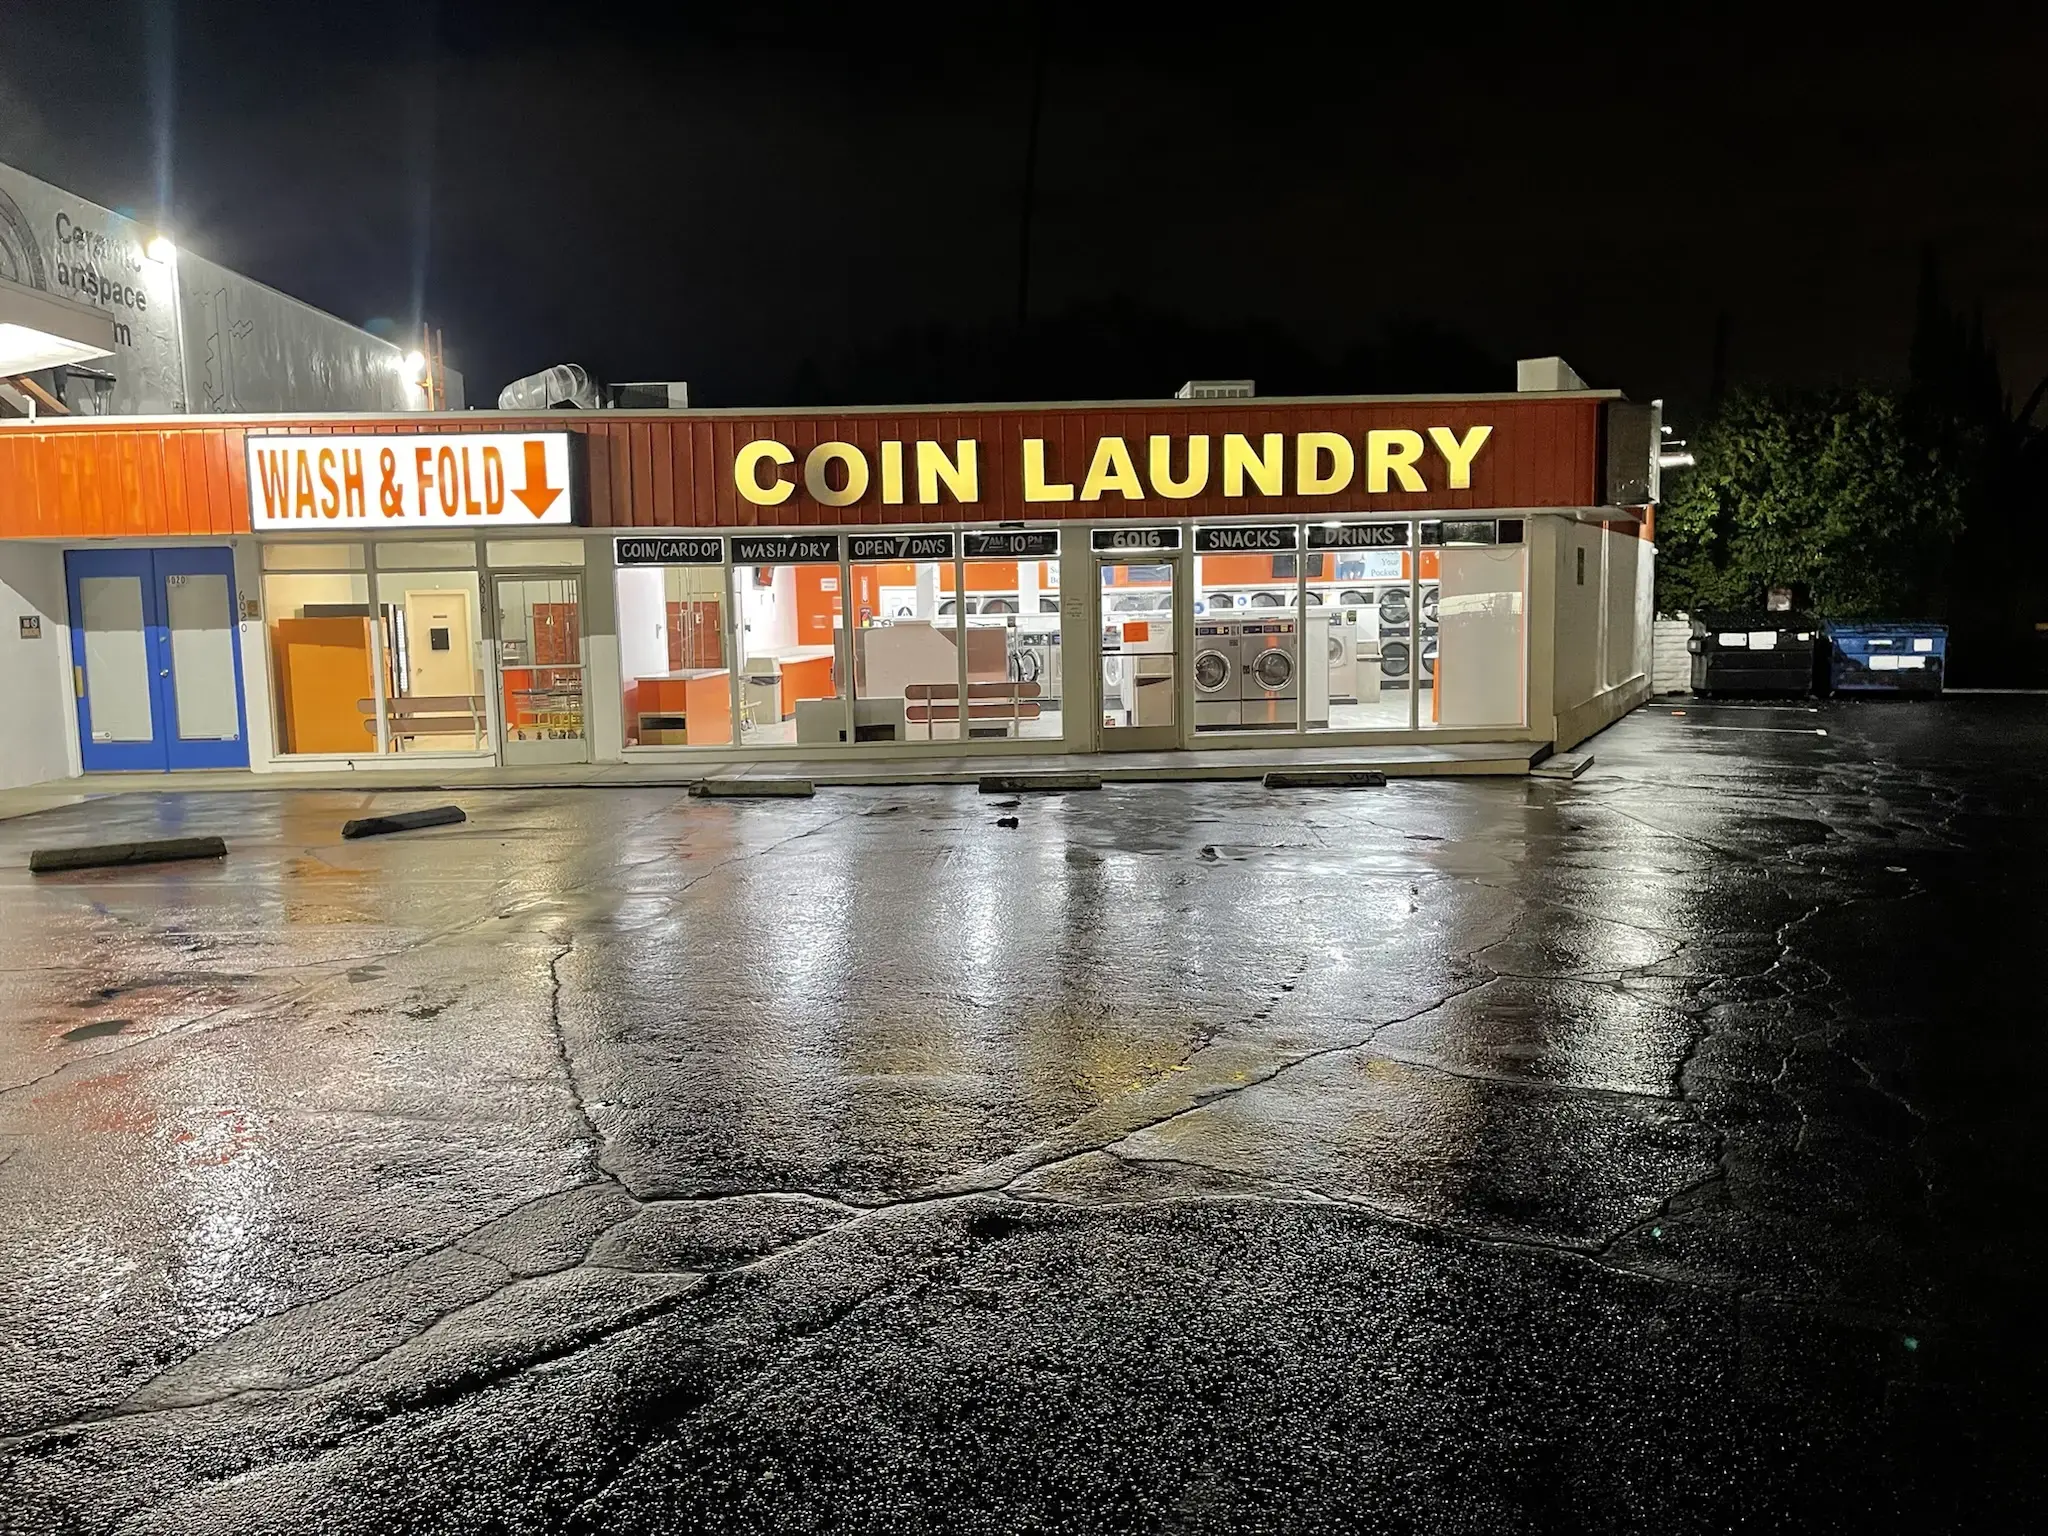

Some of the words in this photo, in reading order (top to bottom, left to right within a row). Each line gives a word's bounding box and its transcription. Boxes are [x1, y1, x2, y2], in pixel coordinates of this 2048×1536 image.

[734, 439, 979, 507] COIN
[1022, 425, 1494, 501] LAUNDRY
[257, 447, 366, 520] WASH
[379, 447, 405, 518] &
[415, 445, 505, 518] FOLD
[1112, 530, 1161, 548] 6016
[1208, 529, 1281, 549] SNACKS
[1324, 526, 1396, 546] DRINKS
[621, 541, 699, 561] COIN/CARD
[700, 541, 720, 557] OP
[854, 540, 894, 556] OPEN
[896, 536, 910, 558] 7
[911, 538, 946, 554] DAYS
[1381, 558, 1399, 566] Your
[238, 590, 247, 633] 6020
